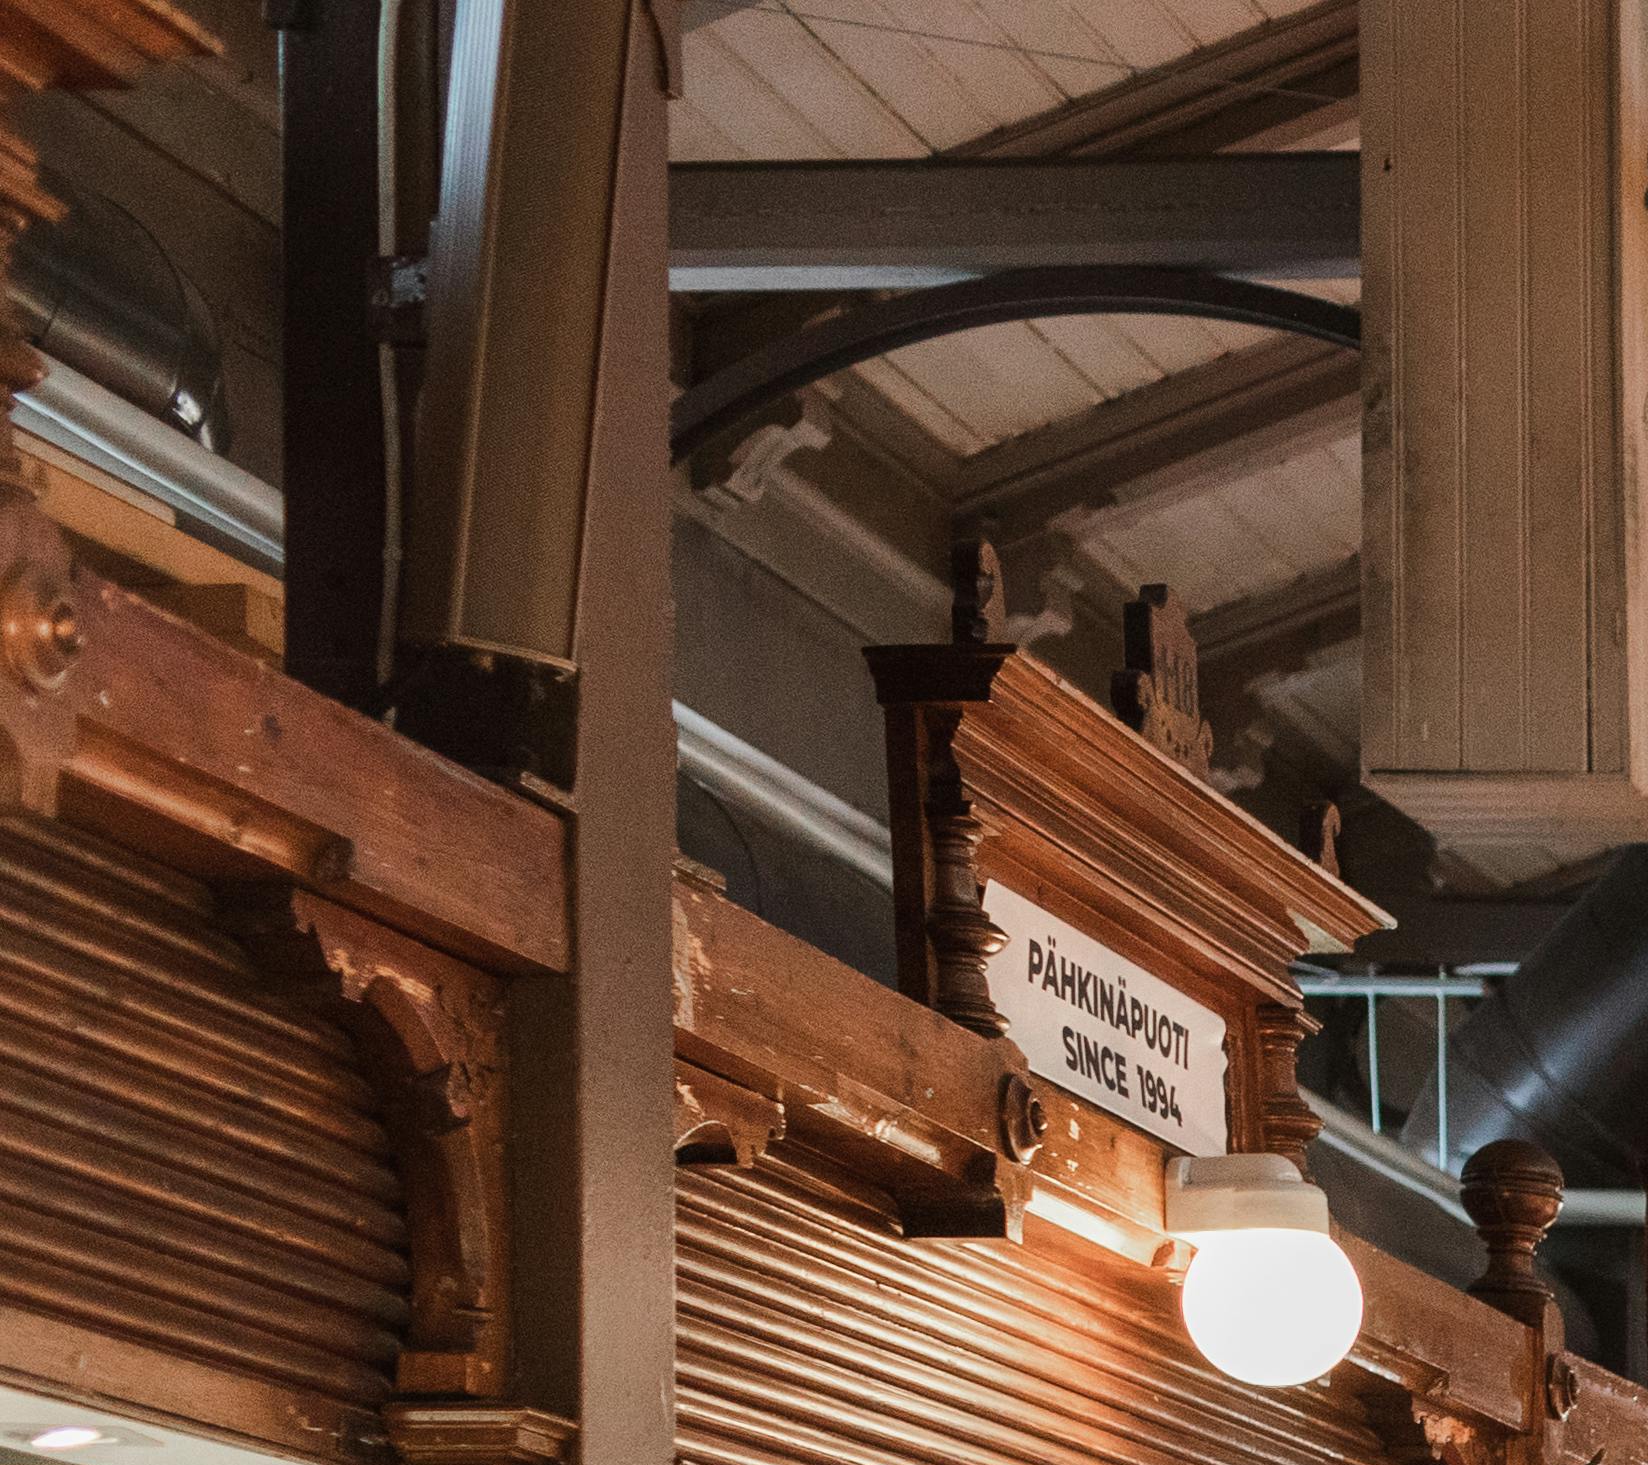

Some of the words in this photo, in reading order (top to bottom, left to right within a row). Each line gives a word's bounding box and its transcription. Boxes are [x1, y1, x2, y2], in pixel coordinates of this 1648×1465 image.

[1028, 936, 1190, 1071] PÄHKINÄPUOTI
[1062, 1025, 1130, 1100] SINCE
[1136, 1064, 1183, 1128] 1994
